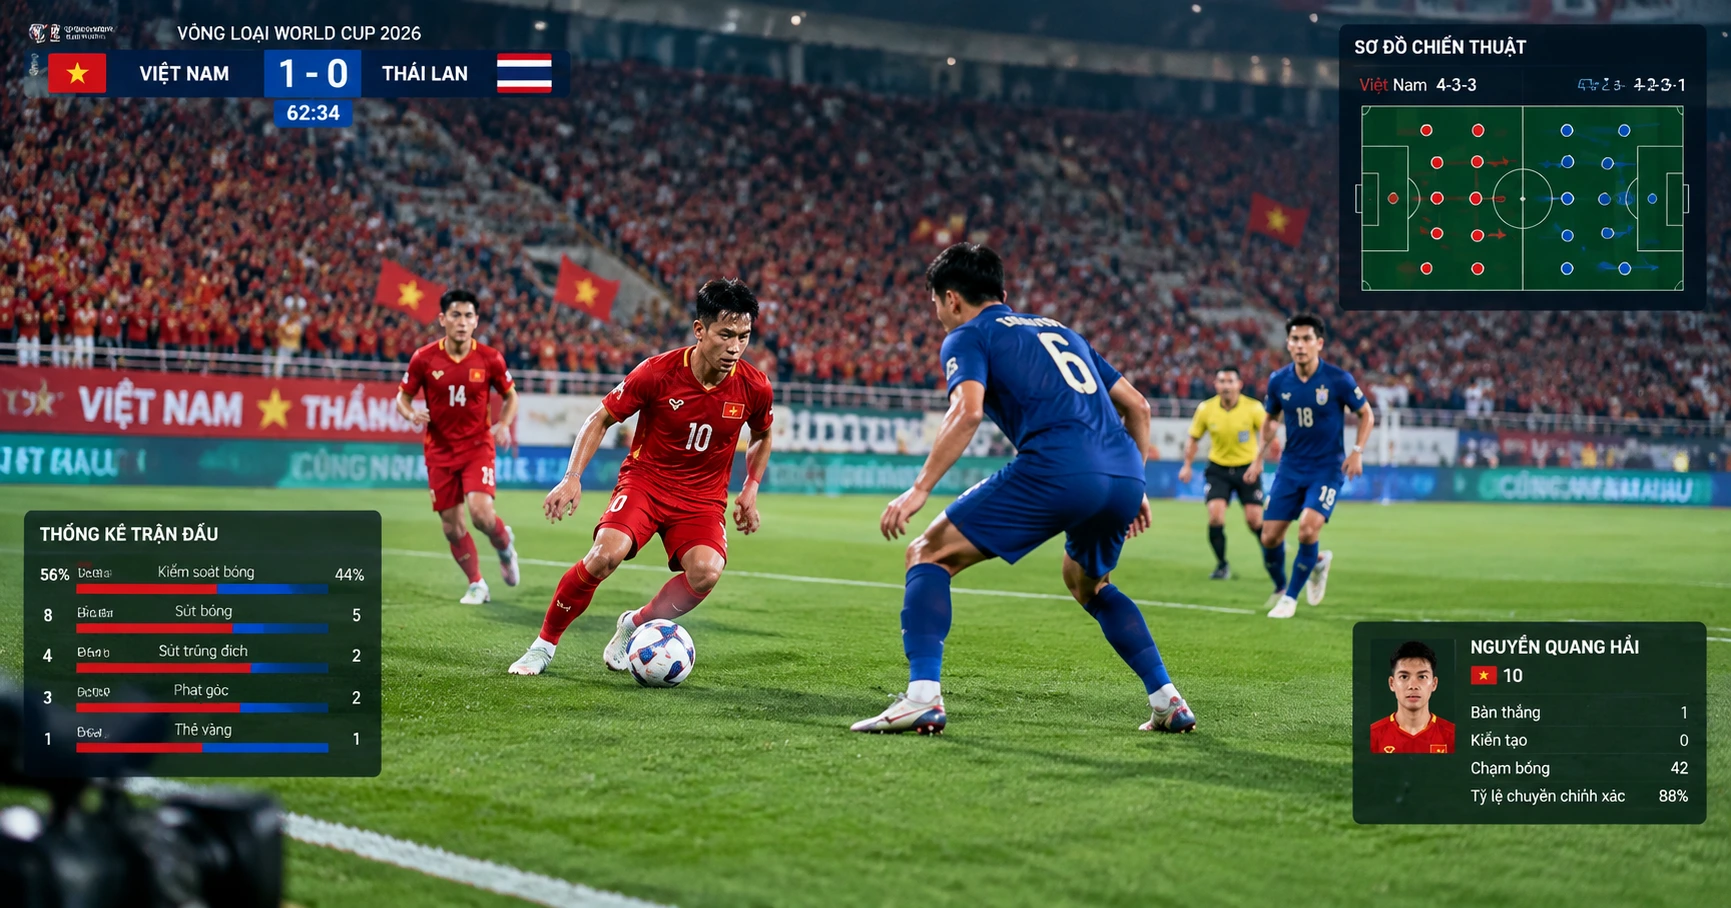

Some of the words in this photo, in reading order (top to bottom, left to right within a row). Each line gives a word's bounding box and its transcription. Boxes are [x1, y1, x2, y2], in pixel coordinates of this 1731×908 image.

[1037, 332, 1098, 395] 6
[78, 377, 156, 430] VIỆT
[162, 388, 244, 428] NAM
[448, 384, 467, 408] 14
[1296, 407, 1314, 428] 18
[685, 422, 713, 452] 10
[1318, 485, 1337, 506] 18
